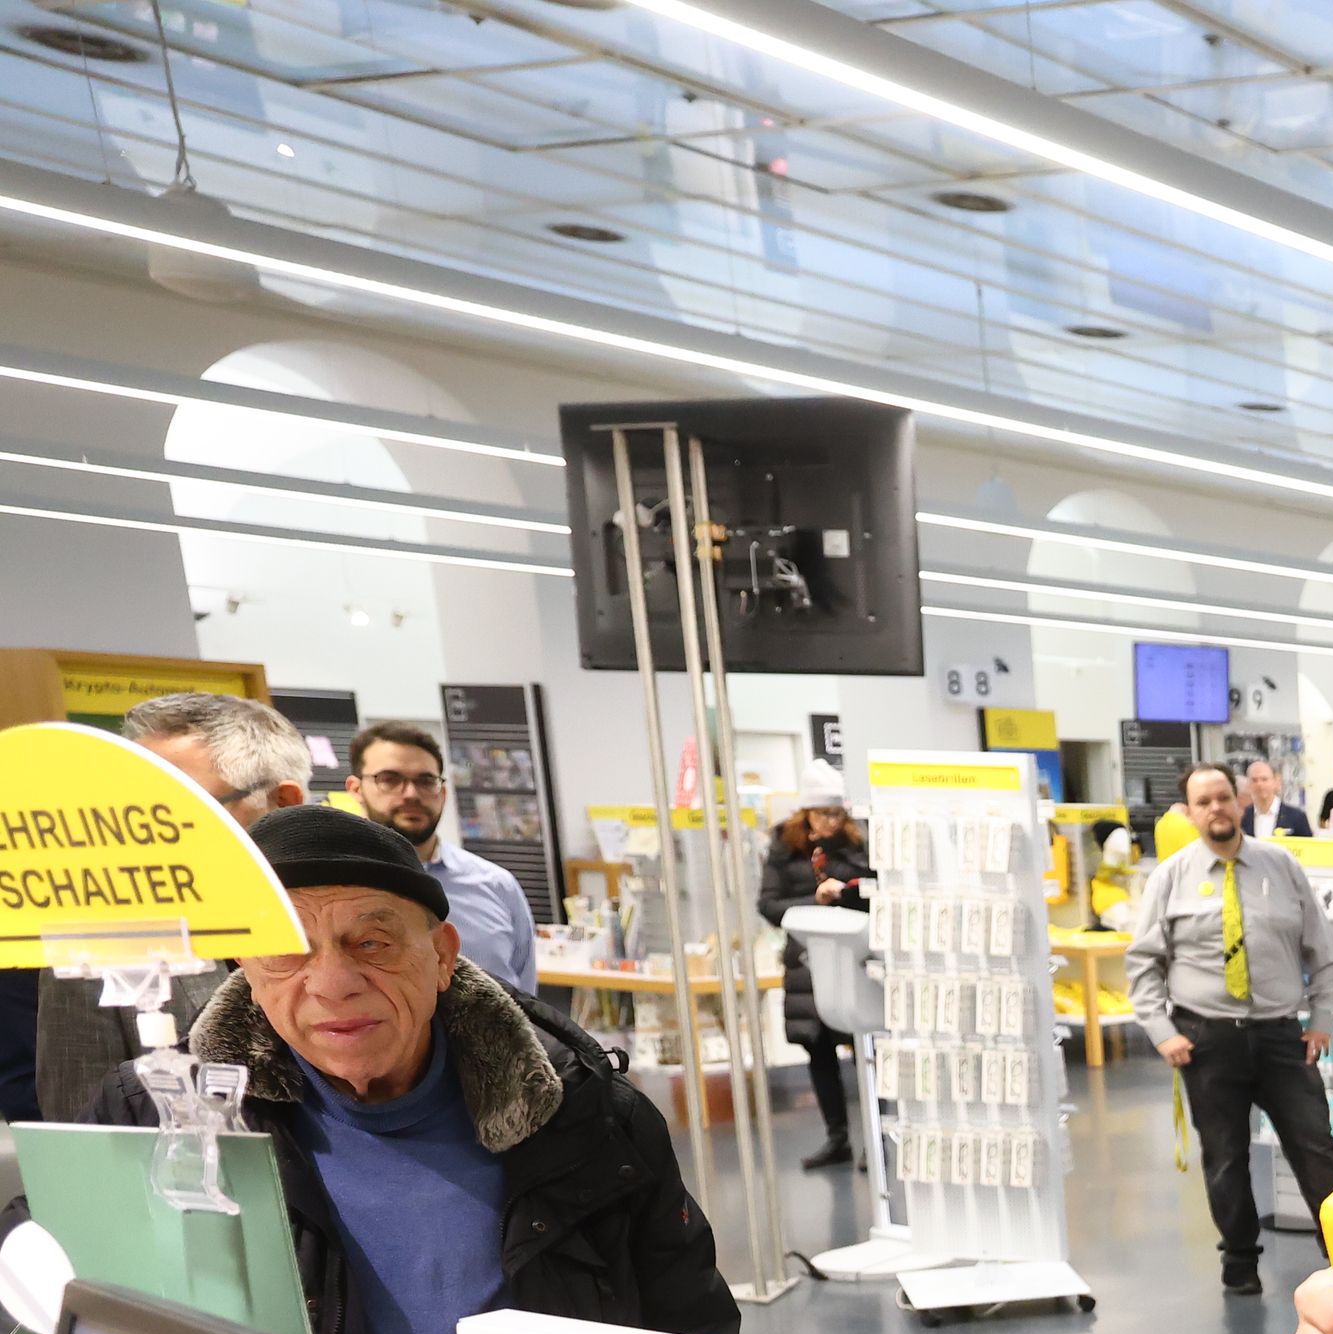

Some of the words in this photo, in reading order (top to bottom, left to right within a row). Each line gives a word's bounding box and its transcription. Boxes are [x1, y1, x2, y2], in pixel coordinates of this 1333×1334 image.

[947, 670, 962, 695] 8
[1252, 689, 1263, 711] 9
[0, 804, 194, 850] HRLINGS-
[0, 864, 203, 909] SCHALTER
